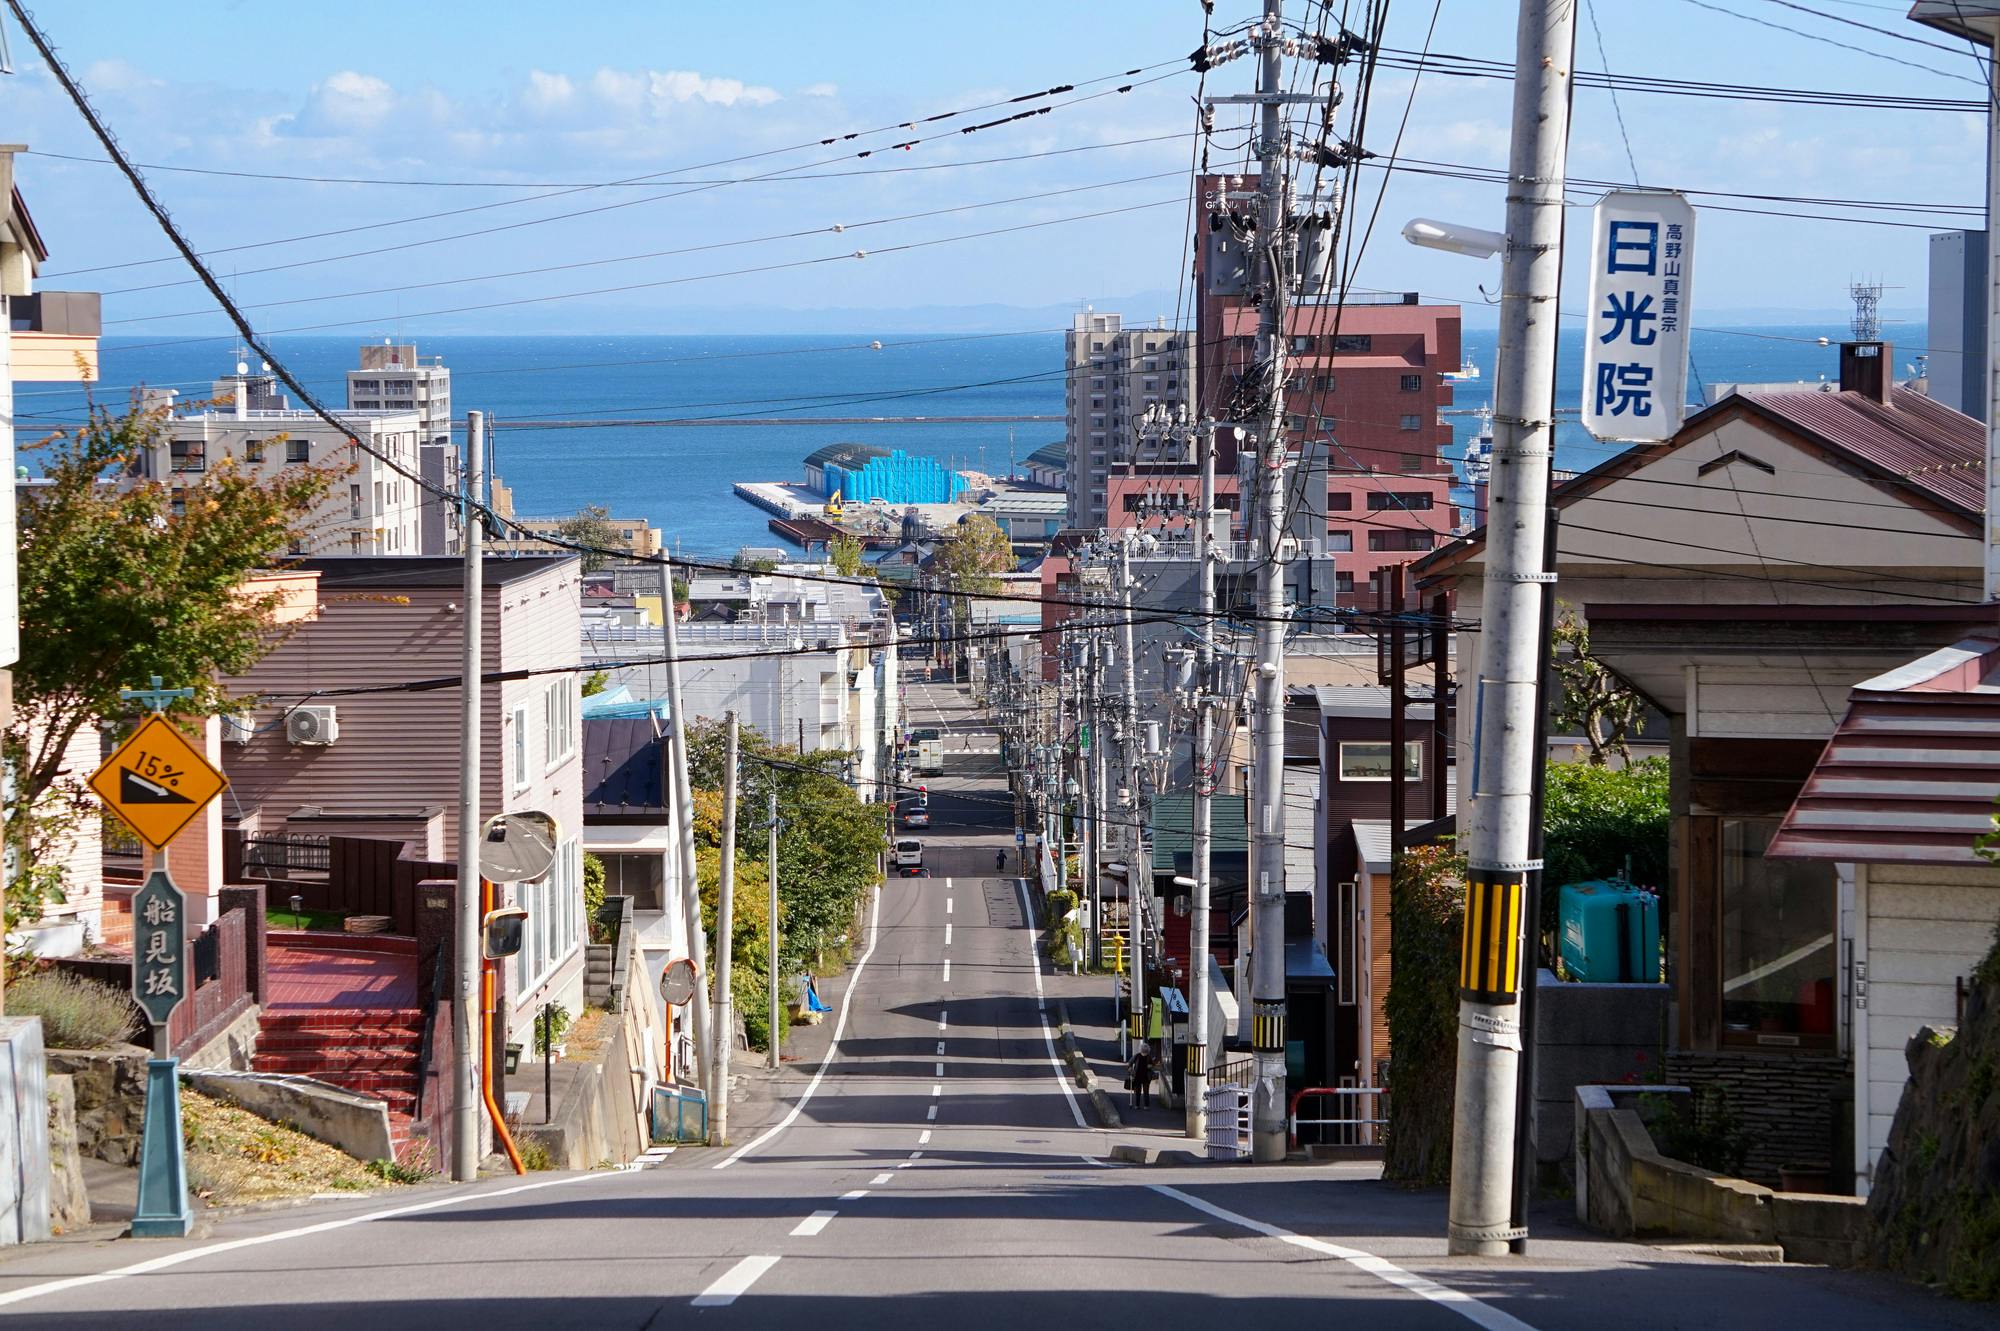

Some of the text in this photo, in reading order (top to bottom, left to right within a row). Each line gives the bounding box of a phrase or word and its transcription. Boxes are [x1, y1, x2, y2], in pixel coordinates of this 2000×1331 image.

[1595, 220, 1659, 418] 日光院
[1660, 223, 1683, 333] 高野山真言宗
[134, 750, 185, 787] 15%
[143, 893, 179, 997] 船見坂
